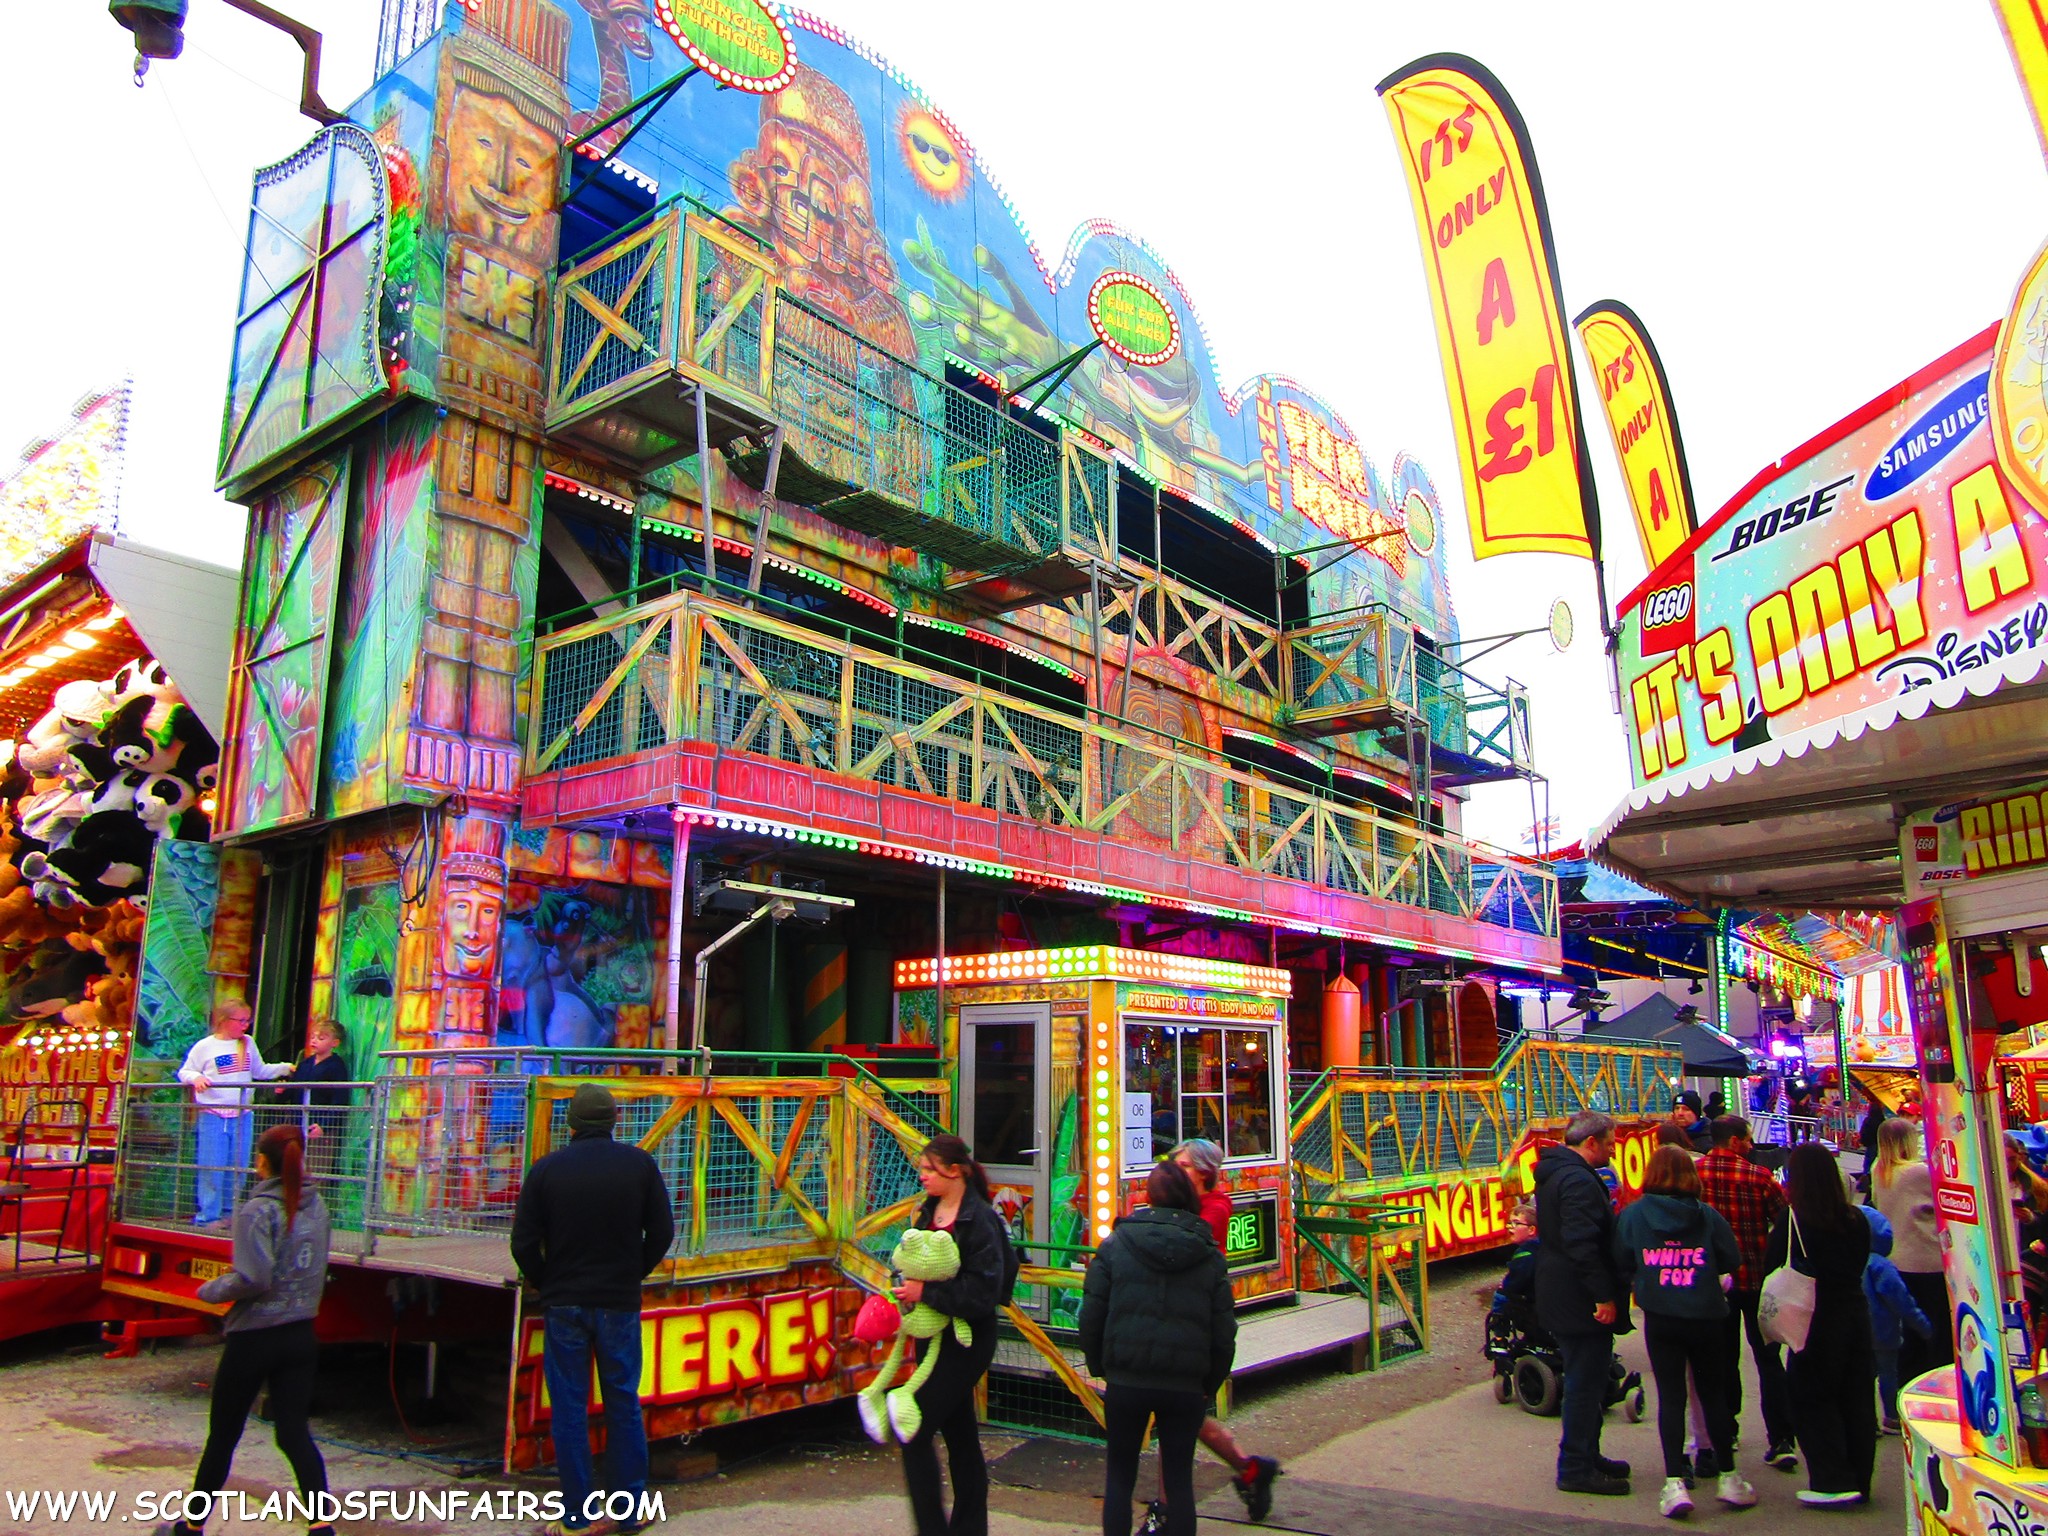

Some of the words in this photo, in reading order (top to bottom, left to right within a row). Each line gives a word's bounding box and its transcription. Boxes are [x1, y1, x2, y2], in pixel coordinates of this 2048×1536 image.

[676, 2, 780, 66] FUNHOUSE
[1437, 166, 1506, 249] ONLY
[1105, 312, 1130, 331] ALL
[1106, 295, 1135, 316] FUN
[1138, 307, 1164, 328] FOR
[1475, 257, 1517, 346] A
[1255, 375, 1284, 514] JUNGLE
[1277, 399, 1370, 498] FUN
[1477, 364, 1556, 483] £1
[1620, 400, 1653, 454] ONLY
[1290, 455, 1408, 580] HOUSE
[1649, 468, 1670, 531] A
[1711, 474, 1855, 562] BOSE
[1630, 626, 1745, 780] IT'S
[1746, 507, 1928, 718] ONLY
[1950, 460, 2034, 617] A
[1643, 583, 1692, 632] LEGO
[1960, 791, 2048, 871] RIN
[1919, 869, 1966, 881] BOSE
[1128, 993, 1176, 1010] PRESENTED
[1178, 997, 1188, 1010] BY
[1191, 998, 1217, 1013] CURTIS
[1220, 1001, 1239, 1014] EDDY
[1242, 1003, 1257, 1016] AND
[1260, 1004, 1275, 1017] SON
[1132, 1137, 1144, 1150] 05
[1382, 1179, 1506, 1258] JUNGLE
[1941, 1194, 1970, 1210] Nintendo
[1642, 1247, 1705, 1266] WHITE
[1659, 1267, 1695, 1286] FOX
